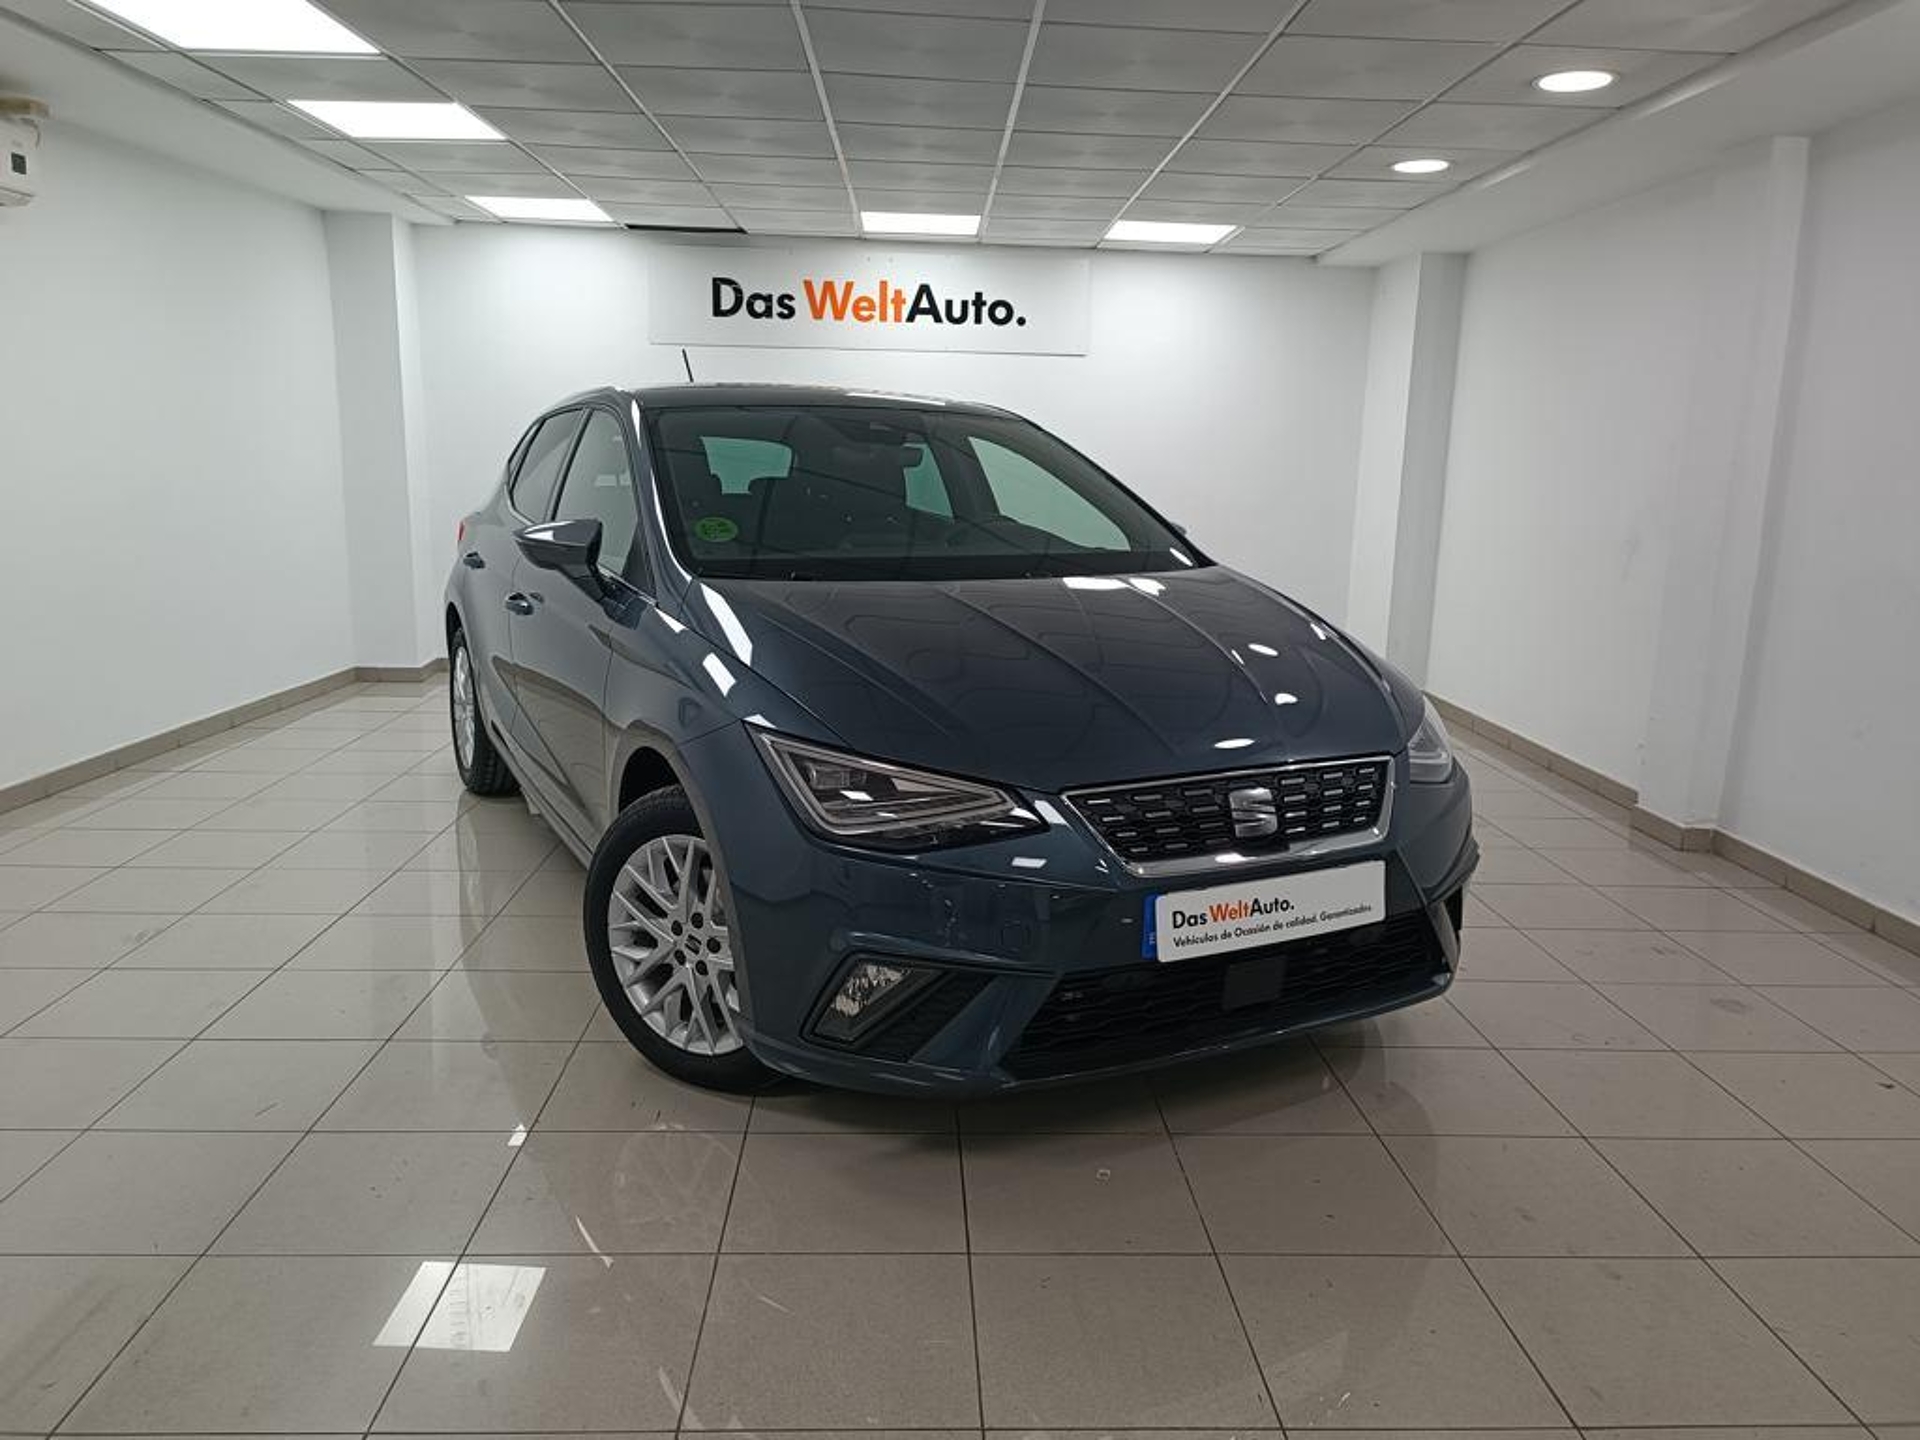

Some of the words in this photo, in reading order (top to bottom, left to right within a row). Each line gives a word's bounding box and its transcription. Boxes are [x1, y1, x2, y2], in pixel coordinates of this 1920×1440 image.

[712, 277, 796, 319] Das
[803, 280, 1027, 326] WeltAuto.
[1172, 910, 1208, 929] Das
[1209, 898, 1294, 922] WeltAuto.
[1221, 929, 1232, 940] de
[1273, 920, 1283, 931] de
